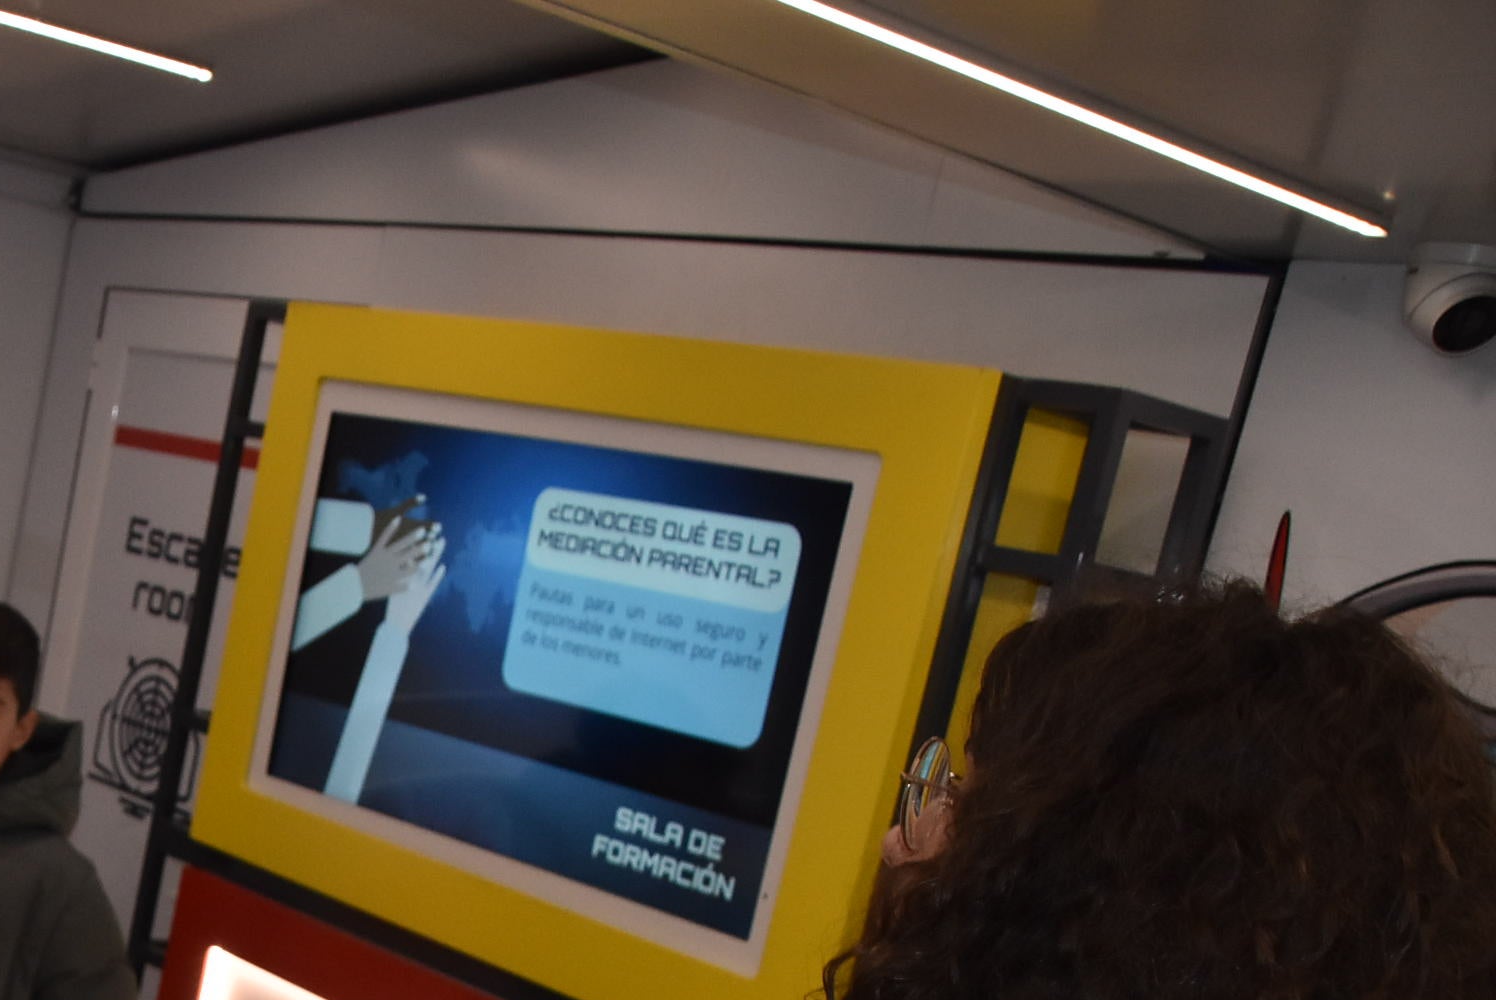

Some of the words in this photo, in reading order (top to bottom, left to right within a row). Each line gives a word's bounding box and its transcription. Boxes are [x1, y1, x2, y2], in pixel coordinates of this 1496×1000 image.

[125, 515, 243, 580] Escae
[537, 528, 645, 565] MEDIACIÓN
[647, 548, 782, 590] PARENTAL?
[548, 503, 658, 538] ¿CONOCES
[662, 519, 708, 547] QUÉ
[712, 528, 744, 553] ES
[748, 534, 781, 560] LA
[131, 580, 195, 624] roo
[583, 595, 616, 616] para
[625, 606, 646, 621] un
[656, 610, 684, 629] uso
[696, 618, 747, 643] seguro
[757, 631, 770, 653] y
[608, 623, 627, 642] de
[688, 643, 718, 662] por
[721, 650, 764, 672] parte
[614, 806, 685, 849] SALA
[687, 828, 726, 862] DE
[591, 834, 737, 902] FORMACIÓN
